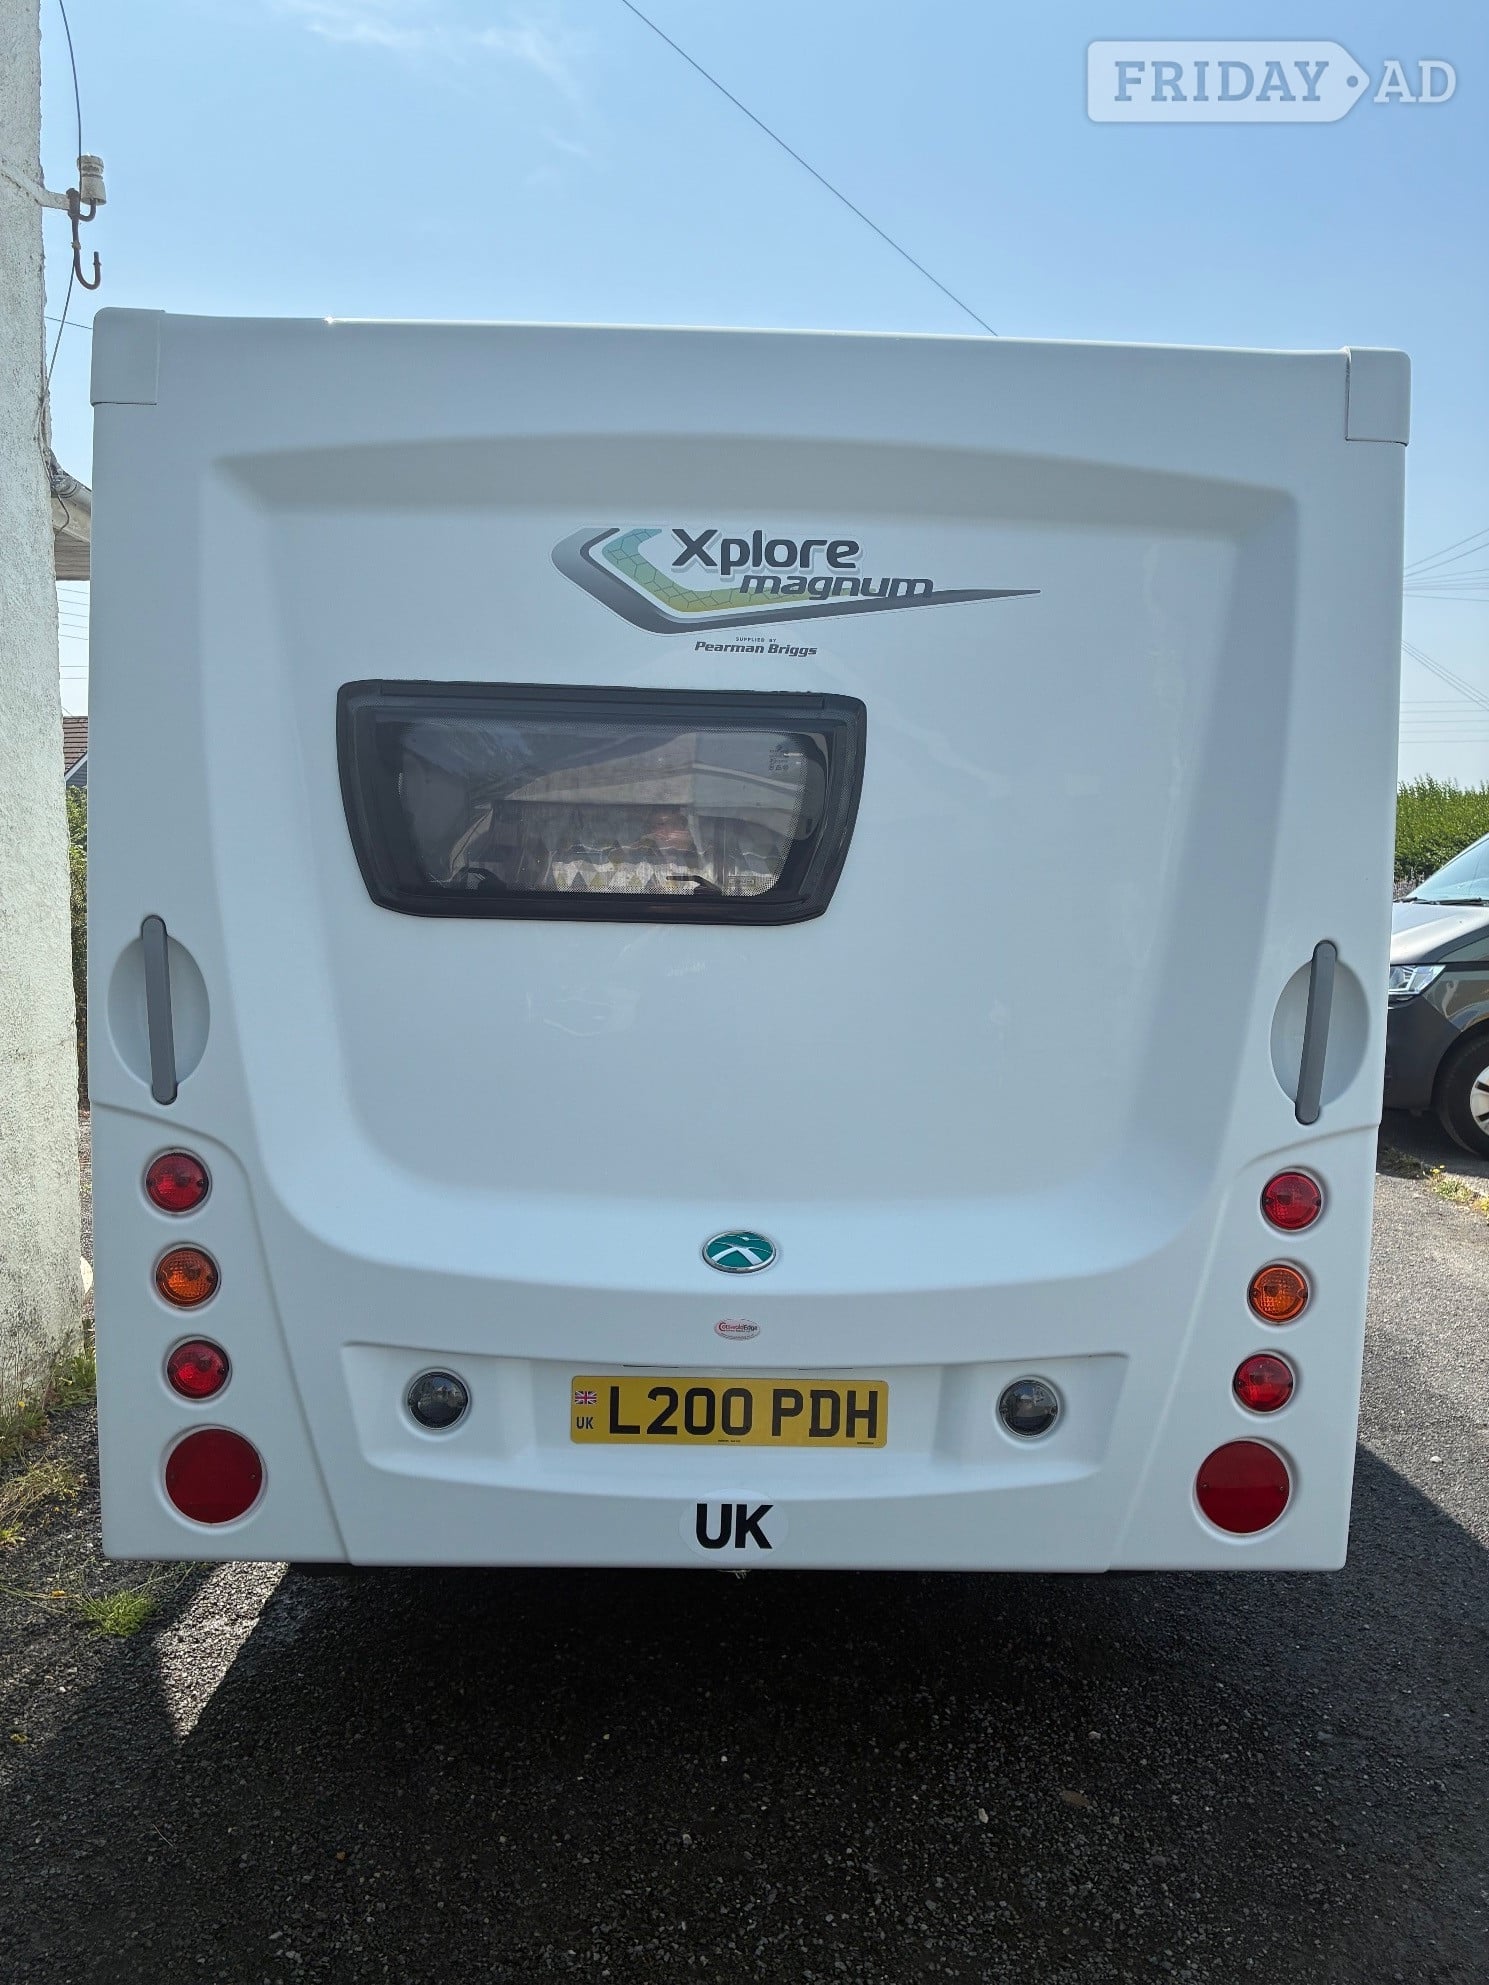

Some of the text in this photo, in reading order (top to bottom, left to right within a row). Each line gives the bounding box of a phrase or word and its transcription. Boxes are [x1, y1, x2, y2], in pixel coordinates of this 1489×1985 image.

[671, 528, 860, 576] Xplore
[739, 575, 934, 601] magnum
[694, 641, 818, 658] Pearman Briggs
[575, 1416, 594, 1430] UK
[609, 1385, 879, 1439] L200 PDH
[695, 1503, 774, 1550] UK
